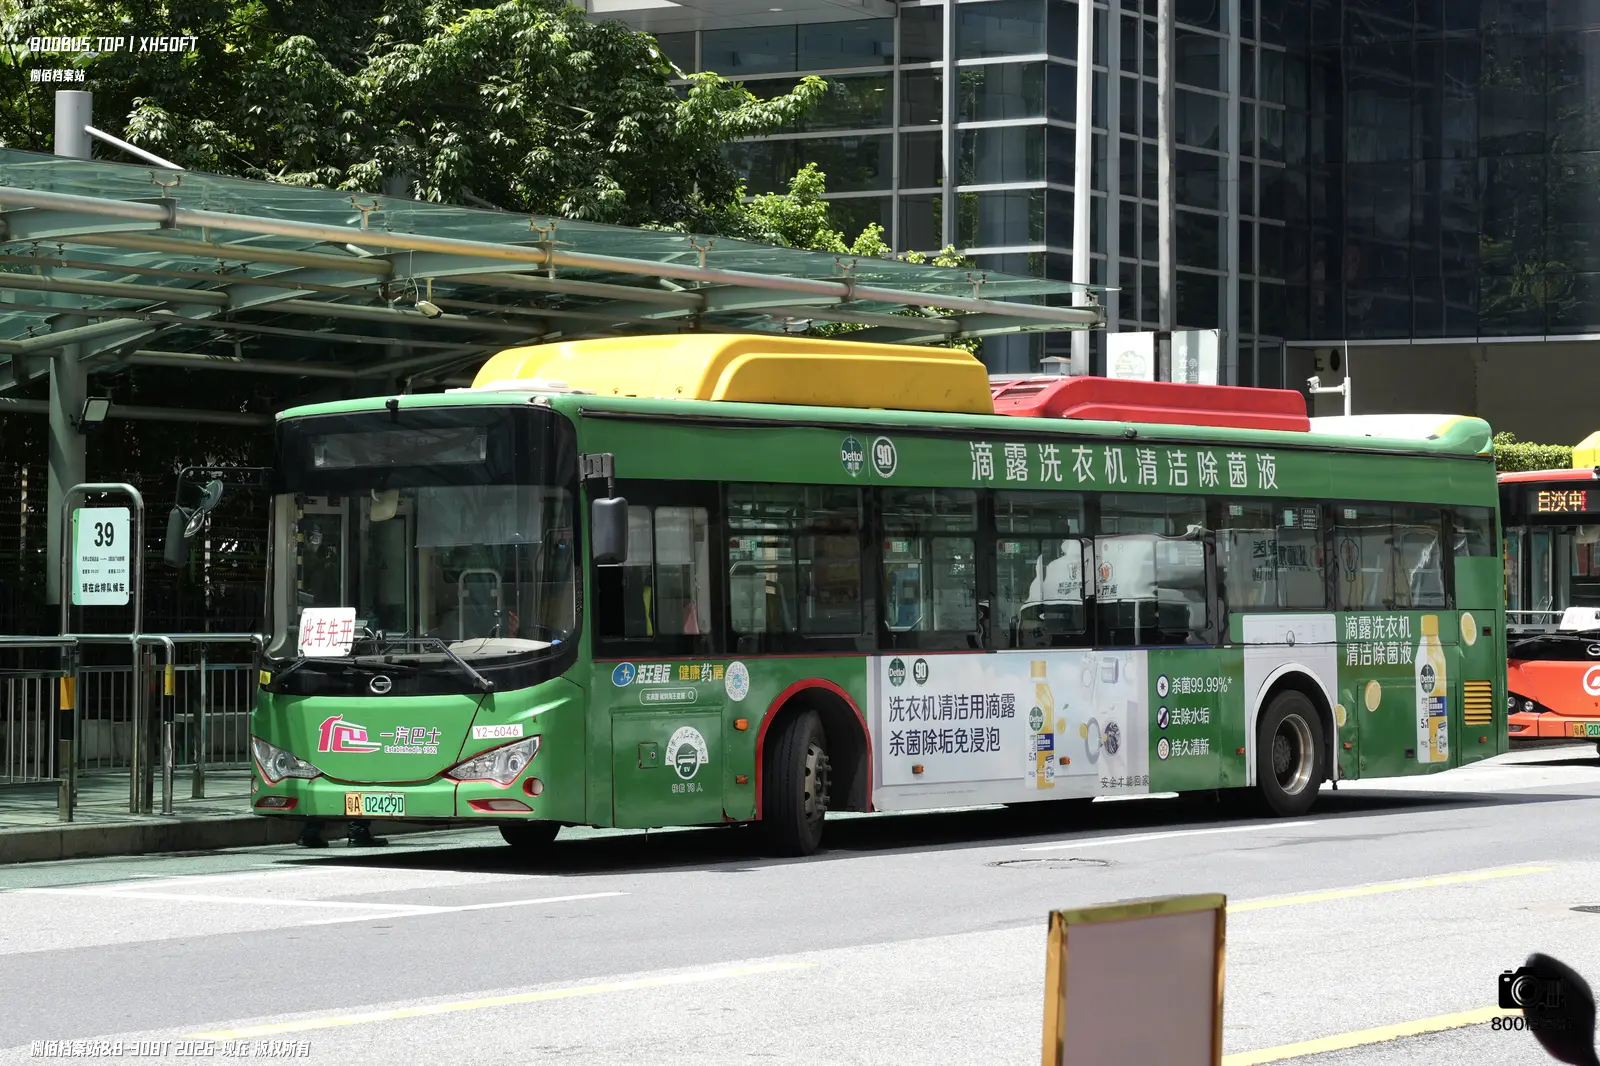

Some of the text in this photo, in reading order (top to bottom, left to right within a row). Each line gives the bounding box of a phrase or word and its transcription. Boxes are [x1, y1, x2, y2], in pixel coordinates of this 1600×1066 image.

[842, 450, 864, 461] Dettol
[877, 444, 892, 466] 90
[969, 440, 1278, 490] 滴露洗衣机清洁除菌液
[94, 521, 114, 547] 39
[82, 582, 125, 593] 请在此排队候车
[301, 618, 352, 648] 此车先开
[1345, 615, 1412, 640] 滴露洗衣机
[1346, 641, 1412, 666] 清洁除菌液
[635, 663, 724, 684] 海王星辰 健康药房
[915, 662, 927, 678] 90
[889, 693, 1016, 722] 洗衣机清洁用滴露
[1171, 707, 1210, 725] 去除水垢
[379, 725, 441, 746] 一汽巴士
[476, 725, 519, 738] Y2-6046
[889, 726, 1001, 757] 杀菌除垢免浸泡
[1171, 738, 1210, 756] 持久清新
[1100, 774, 1150, 788] 安全才能回家
